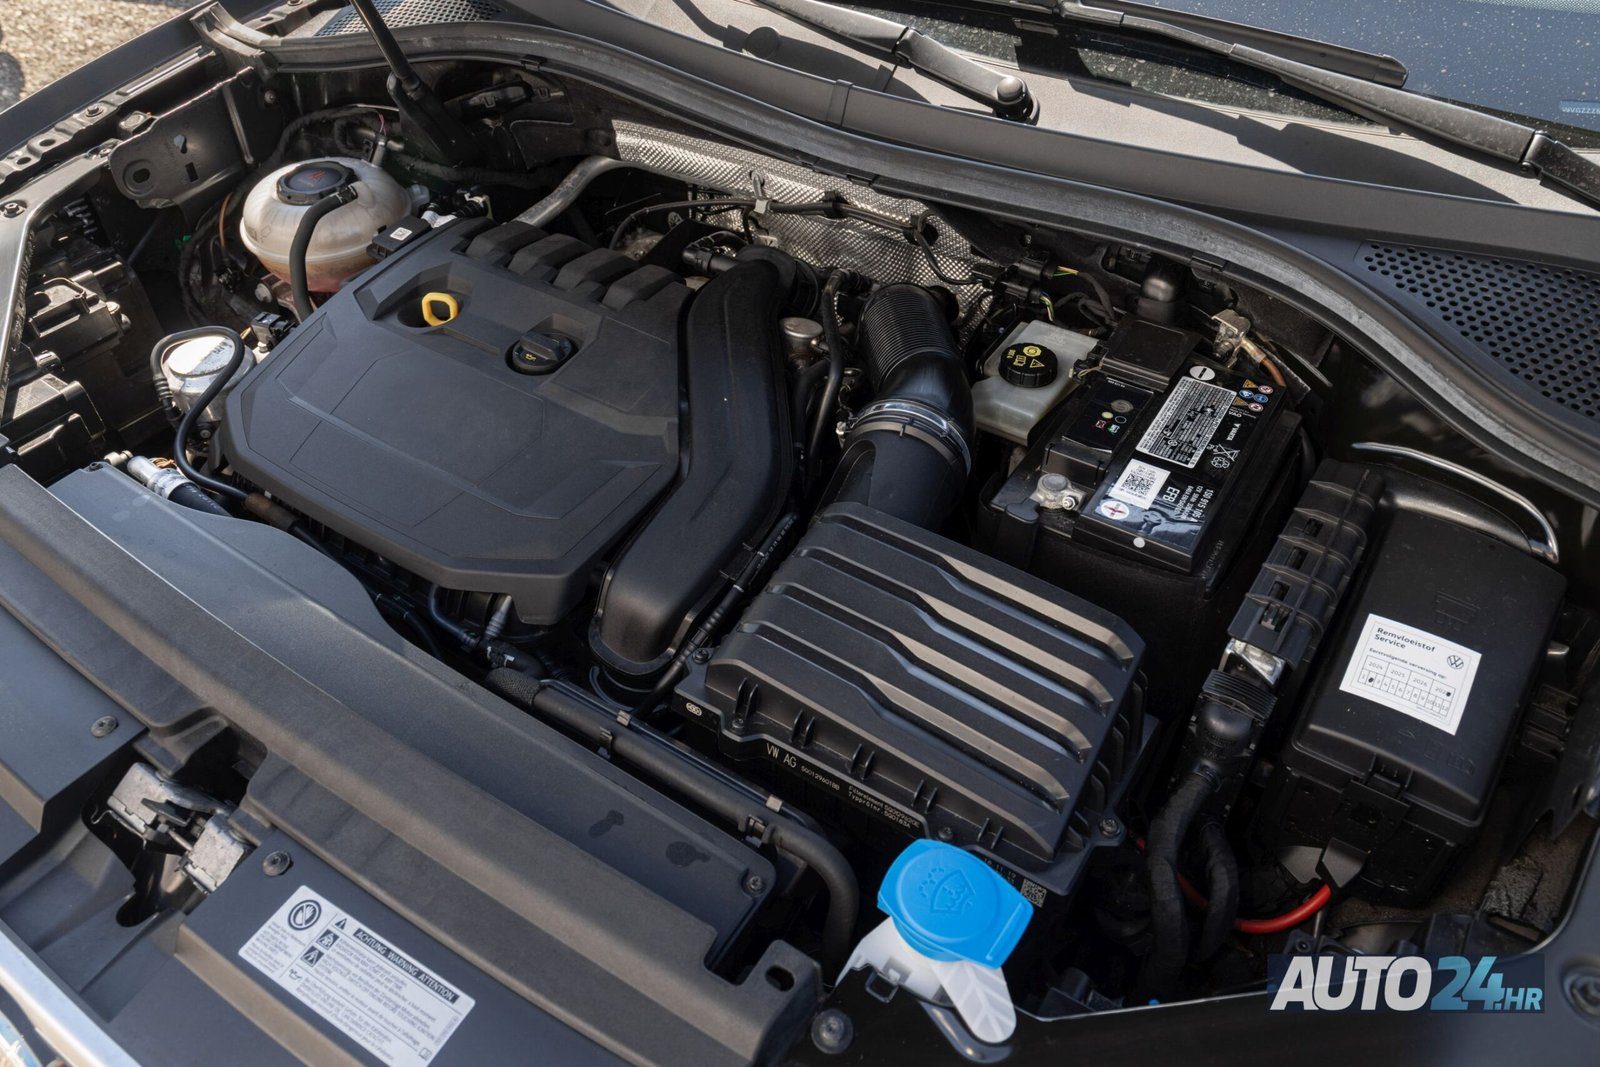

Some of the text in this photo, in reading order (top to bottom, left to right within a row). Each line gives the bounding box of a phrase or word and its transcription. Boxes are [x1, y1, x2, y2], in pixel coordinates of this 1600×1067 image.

[1163, 486, 1180, 502] EFB
[1198, 498, 1208, 508] 915
[1375, 634, 1406, 649] Service
[1377, 627, 1436, 652] Remvloeistof
[767, 743, 779, 758] VW
[783, 754, 796, 768] AG
[356, 931, 455, 1000] ACHTUNG WARNING ATTENTION
